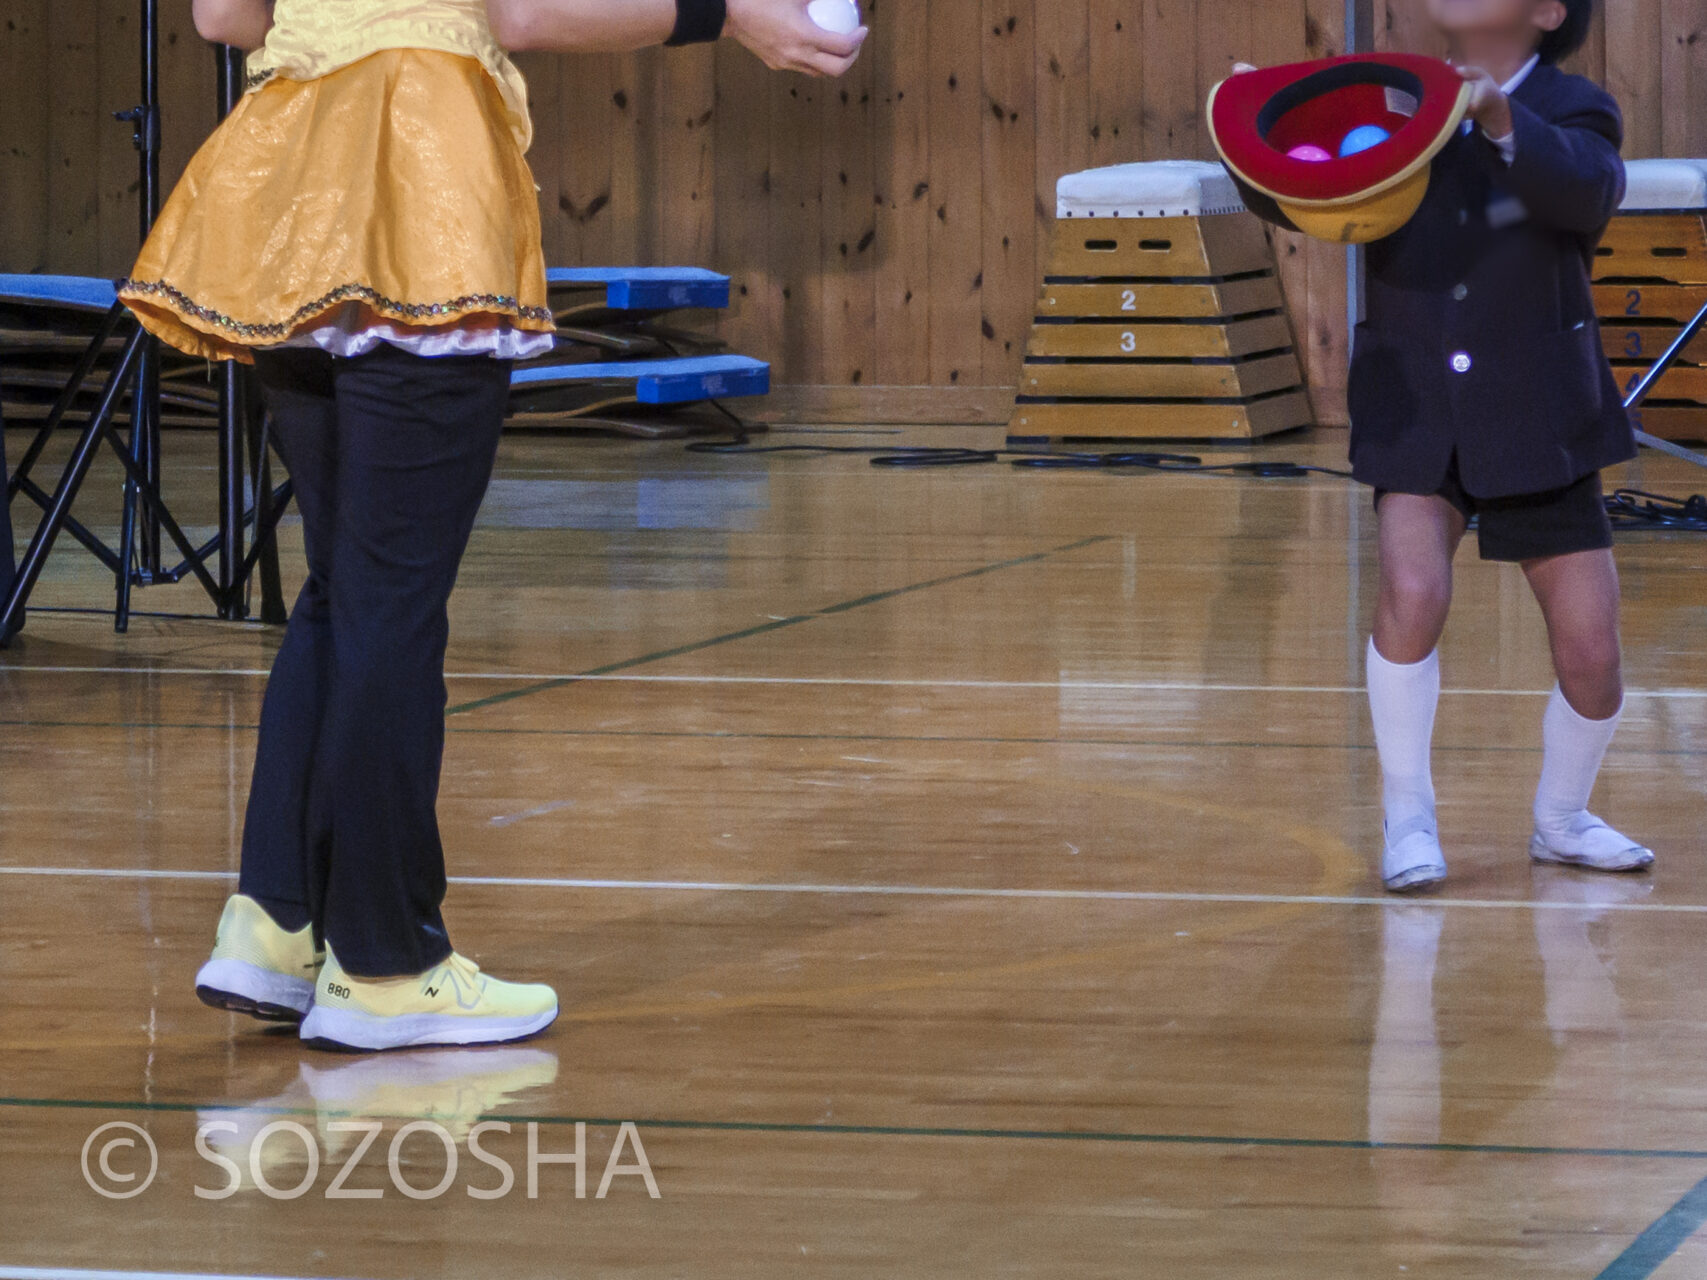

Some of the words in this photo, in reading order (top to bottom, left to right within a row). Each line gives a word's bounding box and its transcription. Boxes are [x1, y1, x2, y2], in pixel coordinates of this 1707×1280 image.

[1121, 290, 1136, 310] 2
[1625, 289, 1641, 316] 2
[1121, 332, 1136, 352] 3
[1625, 331, 1642, 358] 3
[327, 982, 351, 1000] 880
